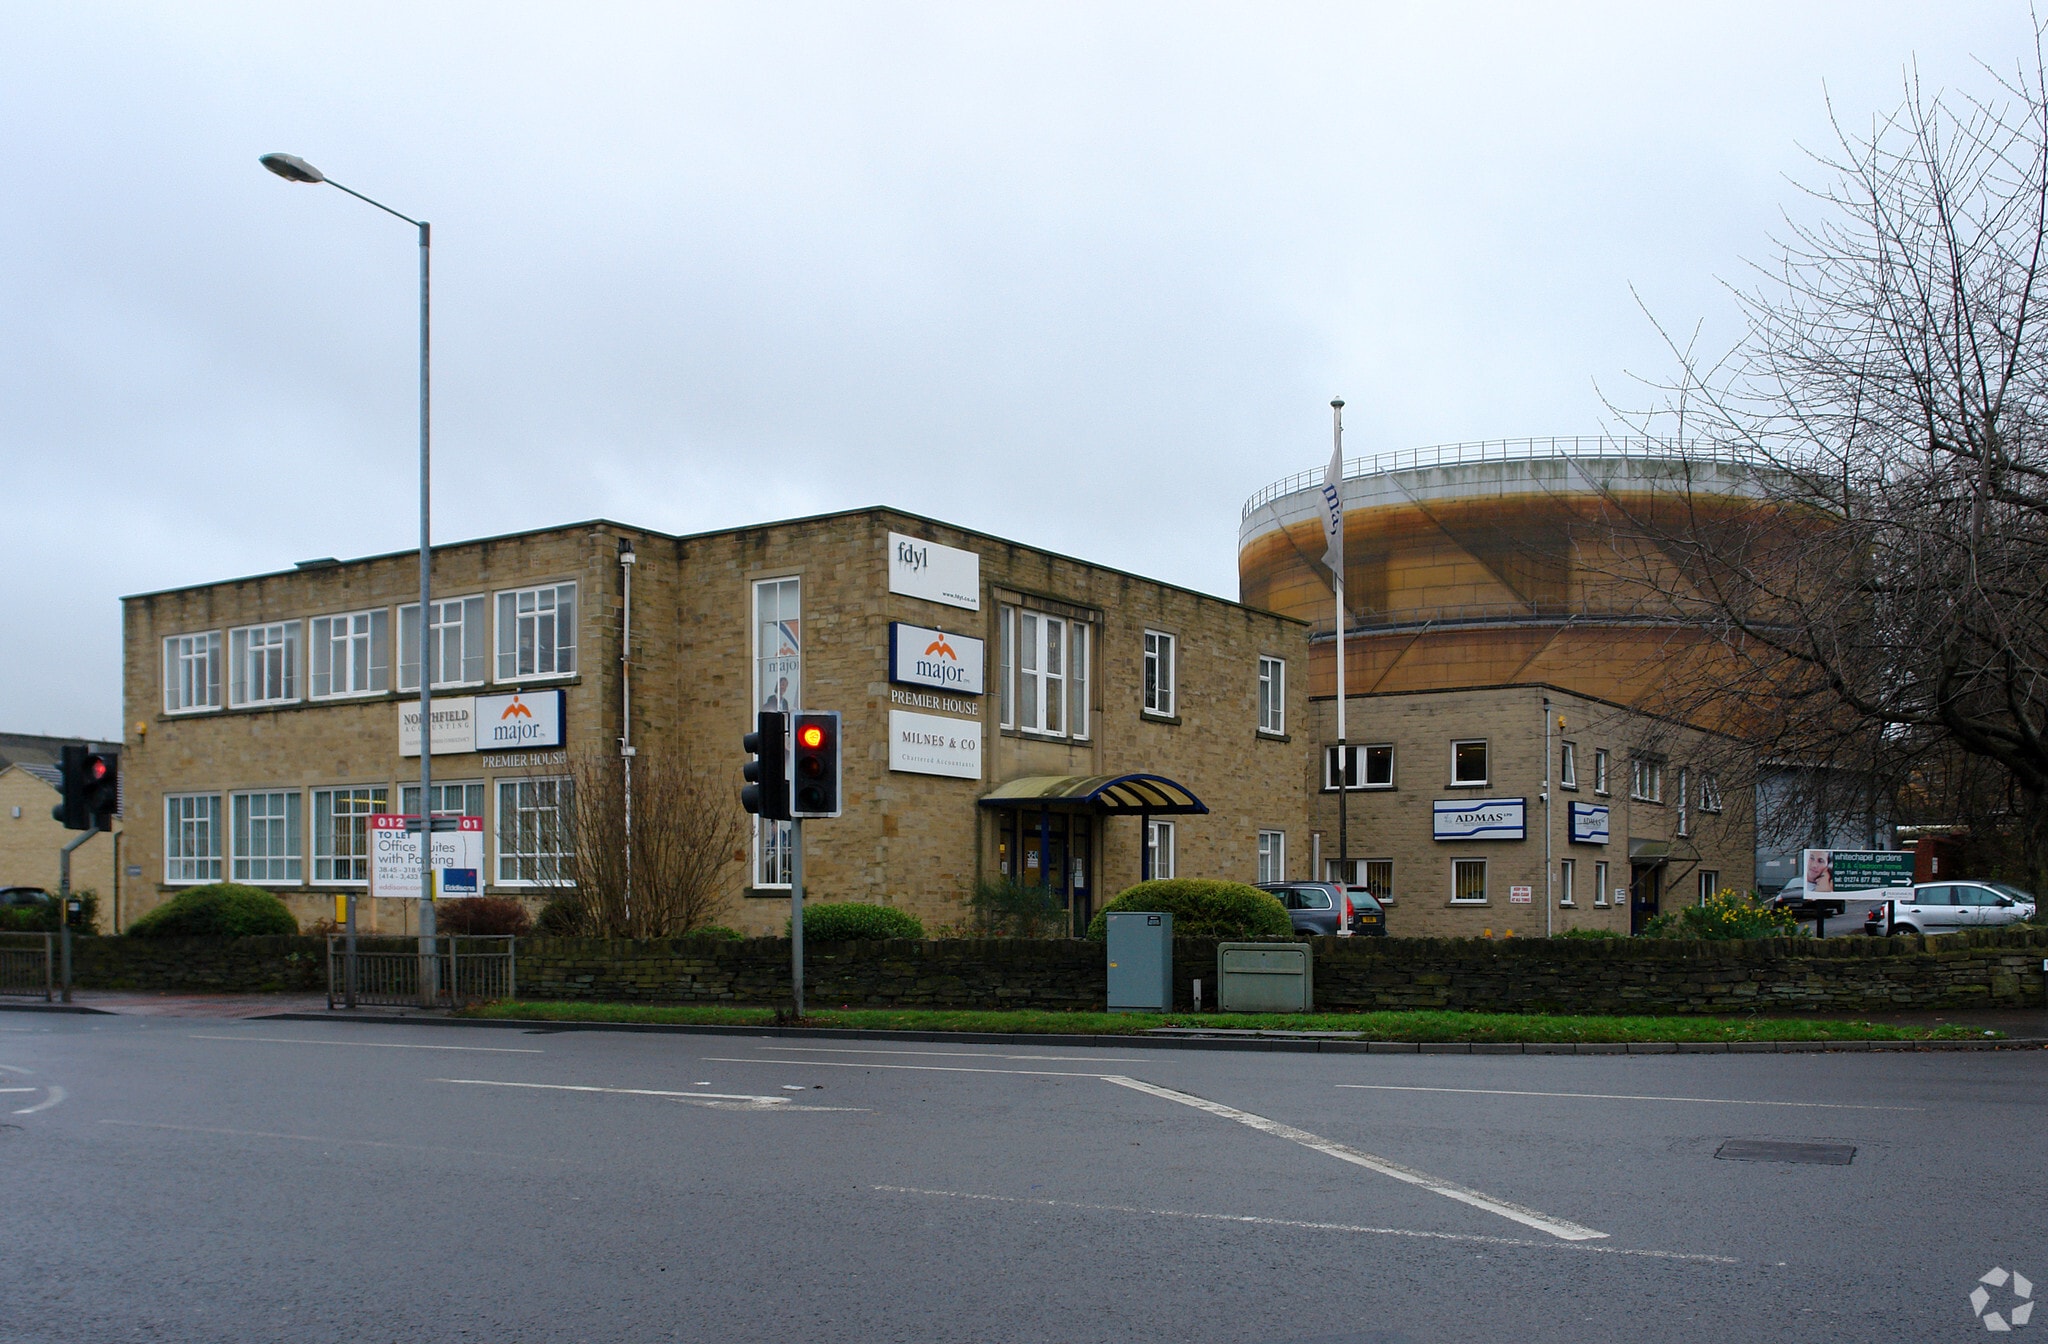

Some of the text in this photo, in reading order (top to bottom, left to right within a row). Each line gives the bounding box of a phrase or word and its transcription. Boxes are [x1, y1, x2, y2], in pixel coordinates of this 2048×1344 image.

[898, 542, 928, 571] fdyl
[916, 659, 964, 685] major
[891, 689, 978, 716] PREMIER HOUSE
[404, 709, 469, 725] NOHFIELD
[405, 722, 470, 732] ACCUNTING
[494, 719, 540, 745] major
[902, 730, 976, 751] MILNES & CO
[482, 751, 567, 768] PREMIER HOUSE
[901, 752, 975, 768] Chartered Accountants
[1455, 813, 1503, 822] ADMAS
[378, 831, 411, 839] TO LET
[378, 839, 456, 853] Office uites
[378, 852, 454, 868] with Paking
[1835, 853, 1902, 863] whitechapel gardens
